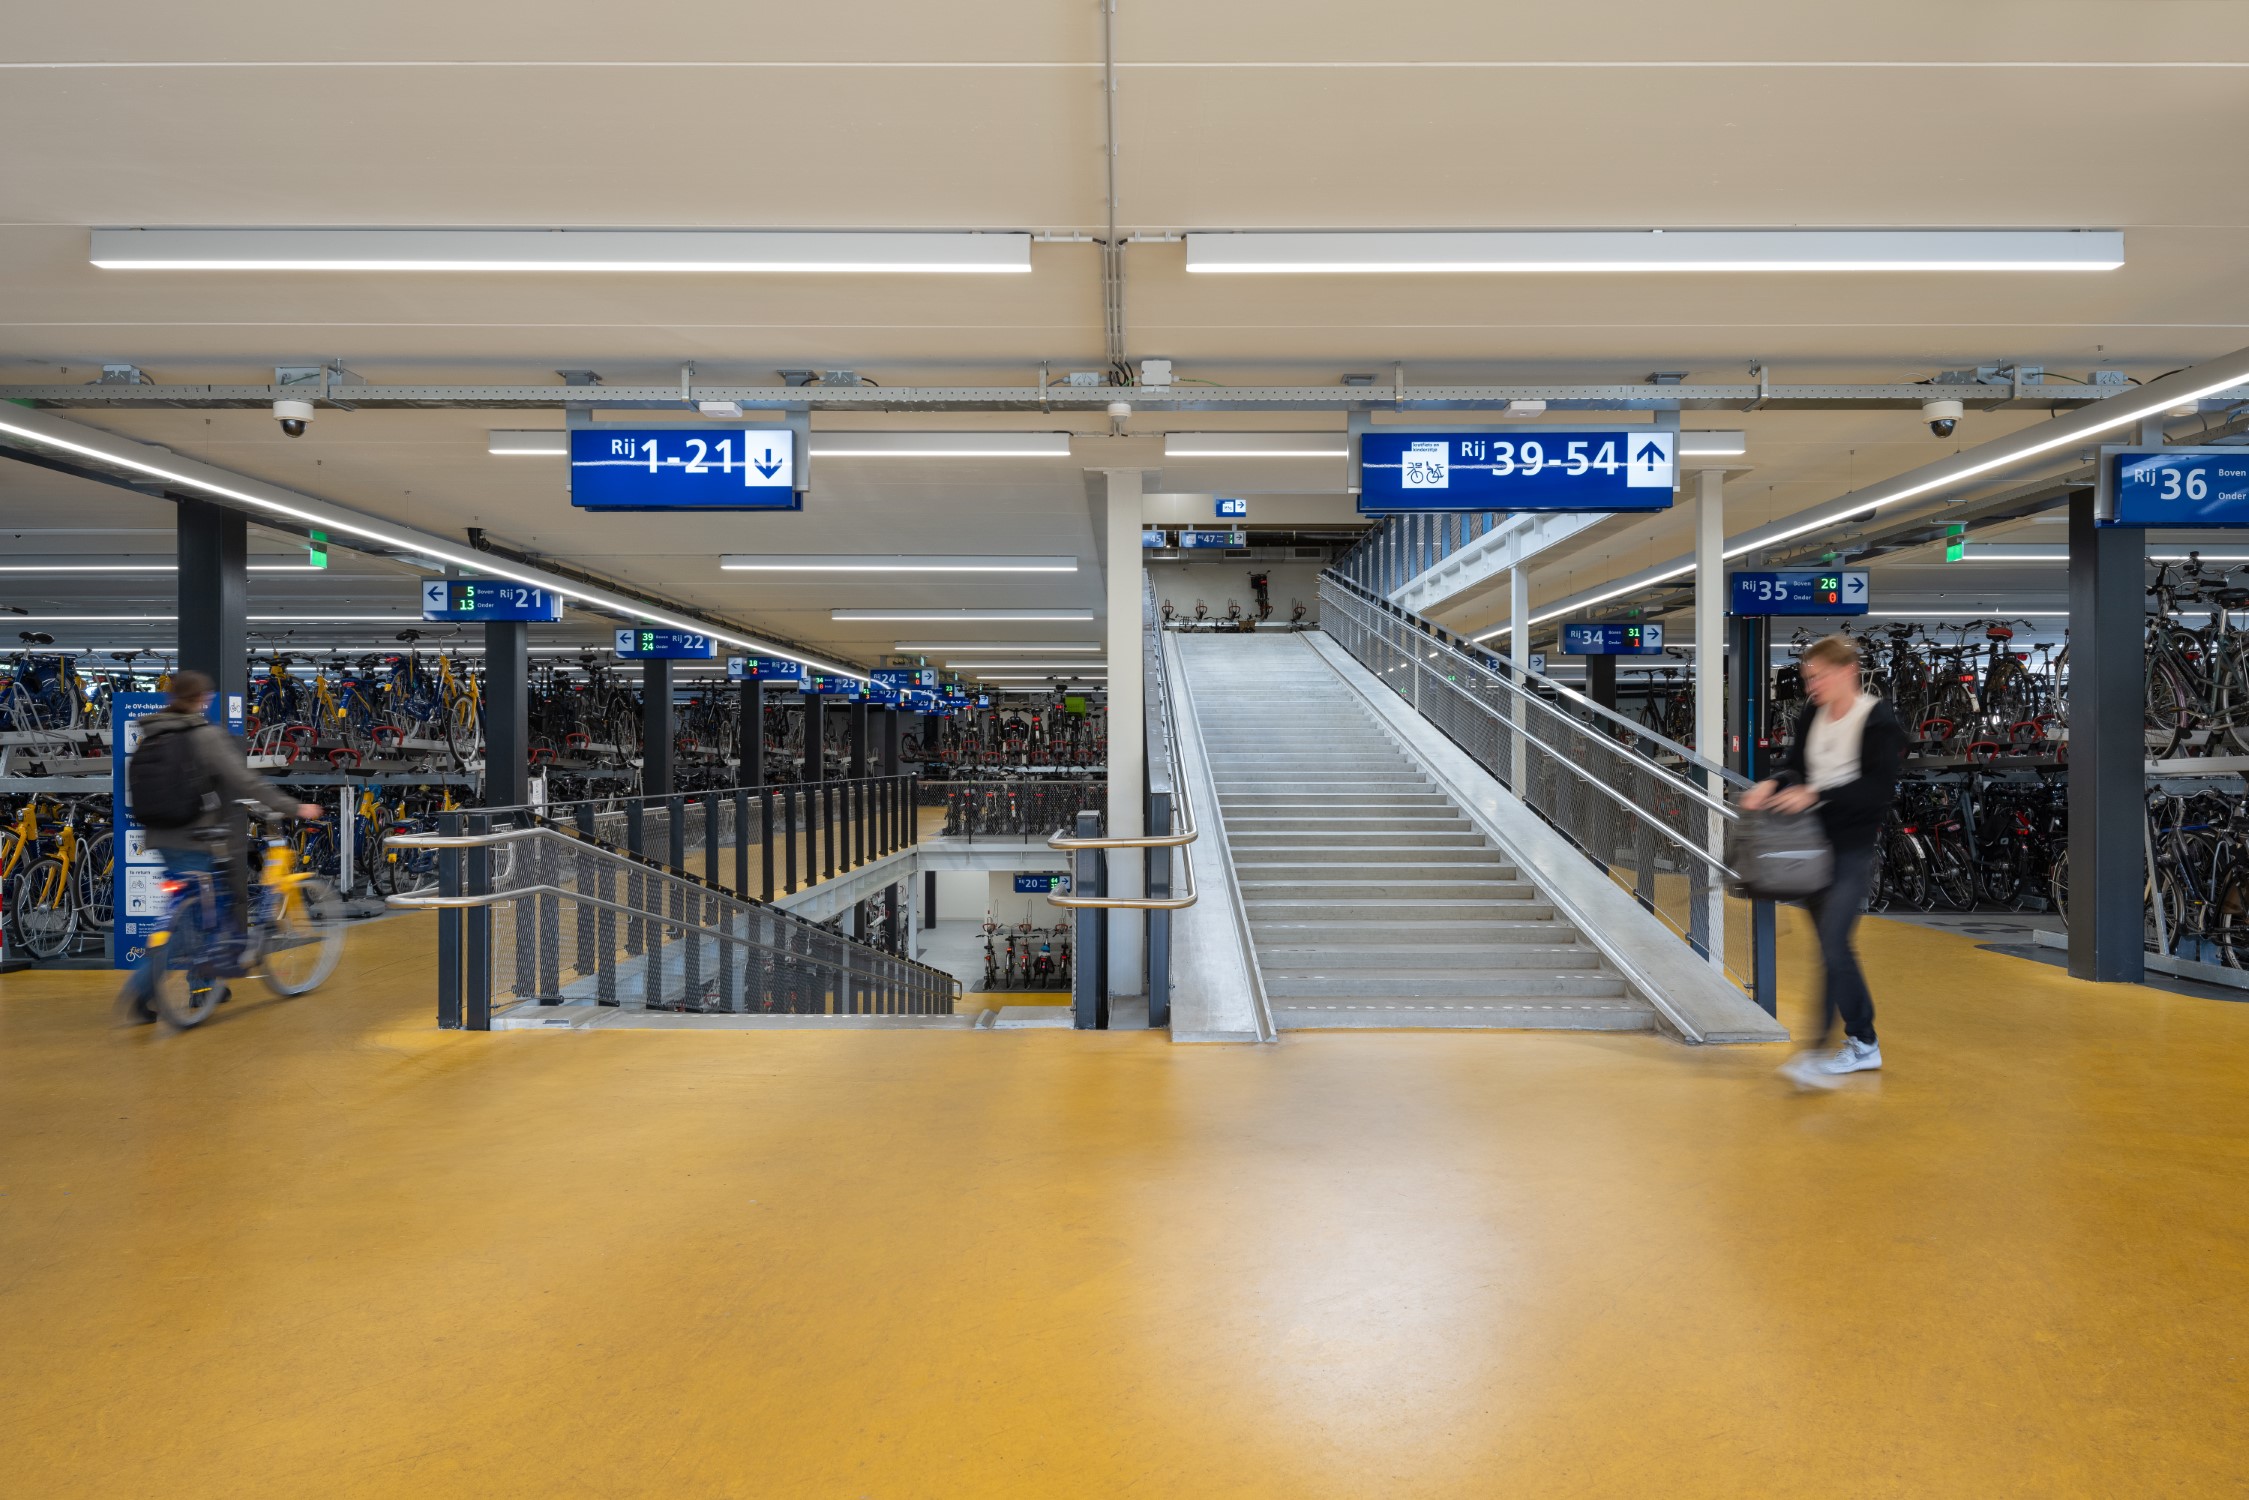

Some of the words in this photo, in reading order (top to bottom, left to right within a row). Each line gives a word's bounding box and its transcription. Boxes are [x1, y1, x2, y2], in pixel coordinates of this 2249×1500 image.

[611, 439, 636, 459] Rij
[640, 439, 732, 474] 1-21
[1461, 441, 1486, 461] Rij
[1492, 441, 1619, 476] 39-54
[2218, 468, 2247, 477] Boven
[2134, 468, 2156, 487] Rij
[2160, 468, 2208, 500] 36
[2218, 492, 2247, 500] Onder
[1150, 535, 1162, 543] 45
[1203, 535, 1215, 543] 47
[1821, 578, 1837, 589] 26
[466, 586, 474, 597] 5
[1742, 581, 1756, 592] Rij
[1758, 580, 1788, 601] 35
[500, 589, 513, 600] Rij
[515, 588, 541, 608] 21
[1828, 592, 1837, 603] 0
[459, 600, 474, 611] 13
[642, 633, 654, 641] 39
[1570, 631, 1581, 639] Rij
[1582, 631, 1604, 645] 34
[1628, 628, 1640, 637] 31
[642, 643, 654, 651] 24
[672, 635, 683, 643] Rij
[684, 635, 705, 649] 22
[1634, 639, 1640, 647] 1
[780, 662, 797, 673] 23
[842, 679, 856, 688] 25
[881, 673, 896, 684] 24
[885, 690, 897, 699] 27
[1025, 879, 1038, 888] 20
